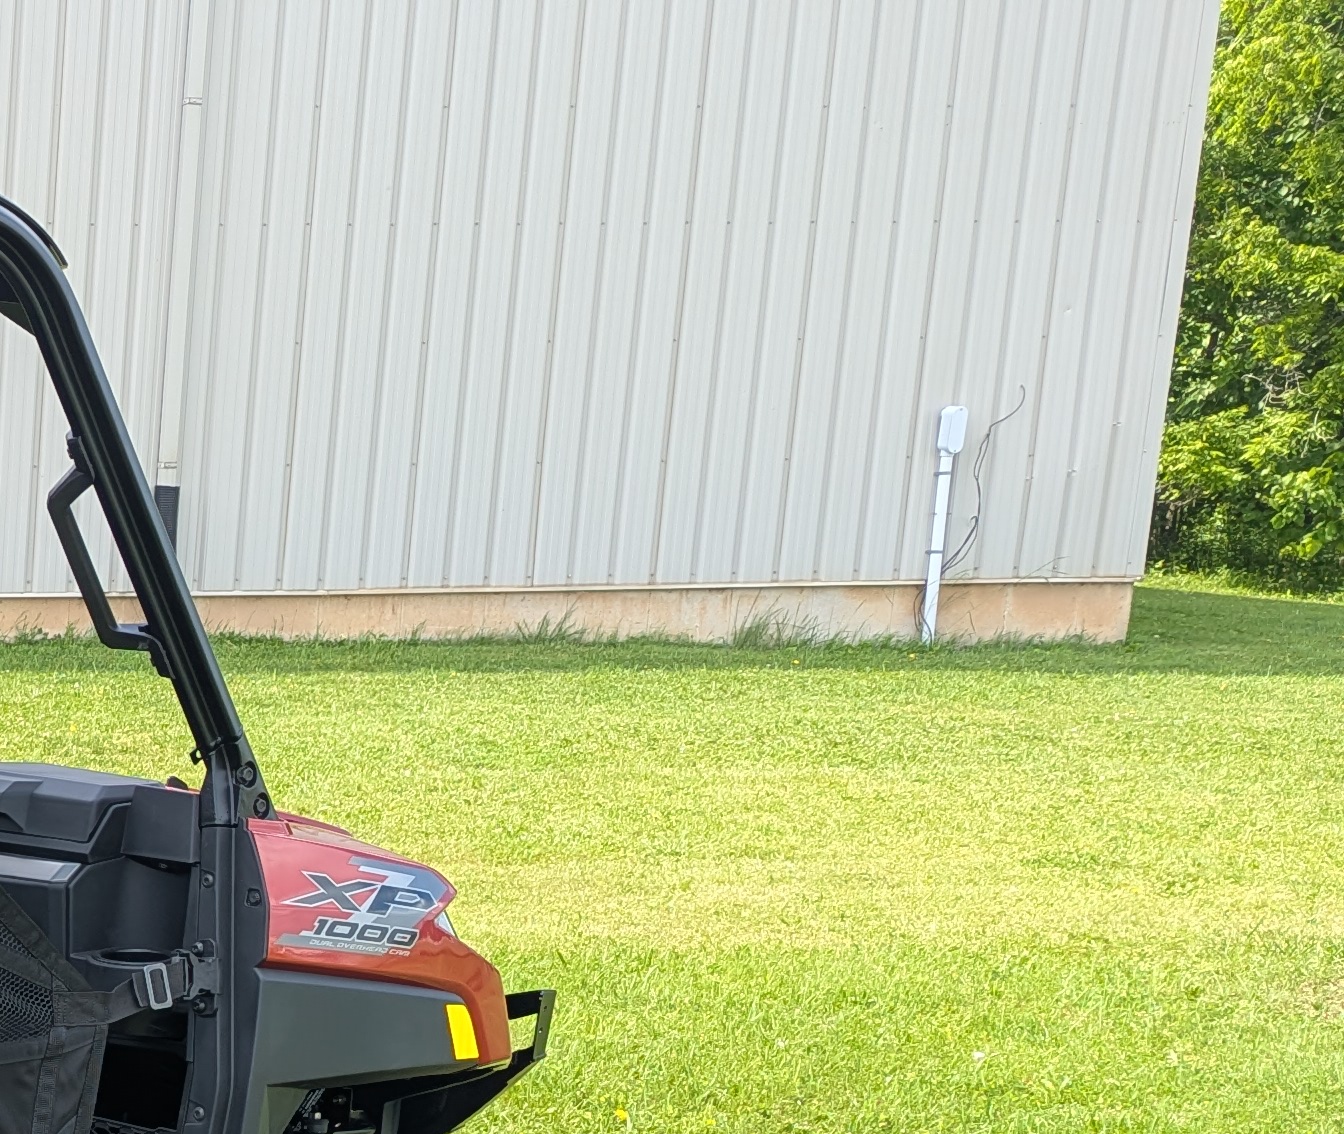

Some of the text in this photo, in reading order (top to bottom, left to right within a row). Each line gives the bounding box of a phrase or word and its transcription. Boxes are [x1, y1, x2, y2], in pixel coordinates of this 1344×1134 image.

[280, 870, 438, 914] XP
[309, 939, 411, 957] DUAL OVERHEAD CAM
[312, 918, 419, 950] 1000
